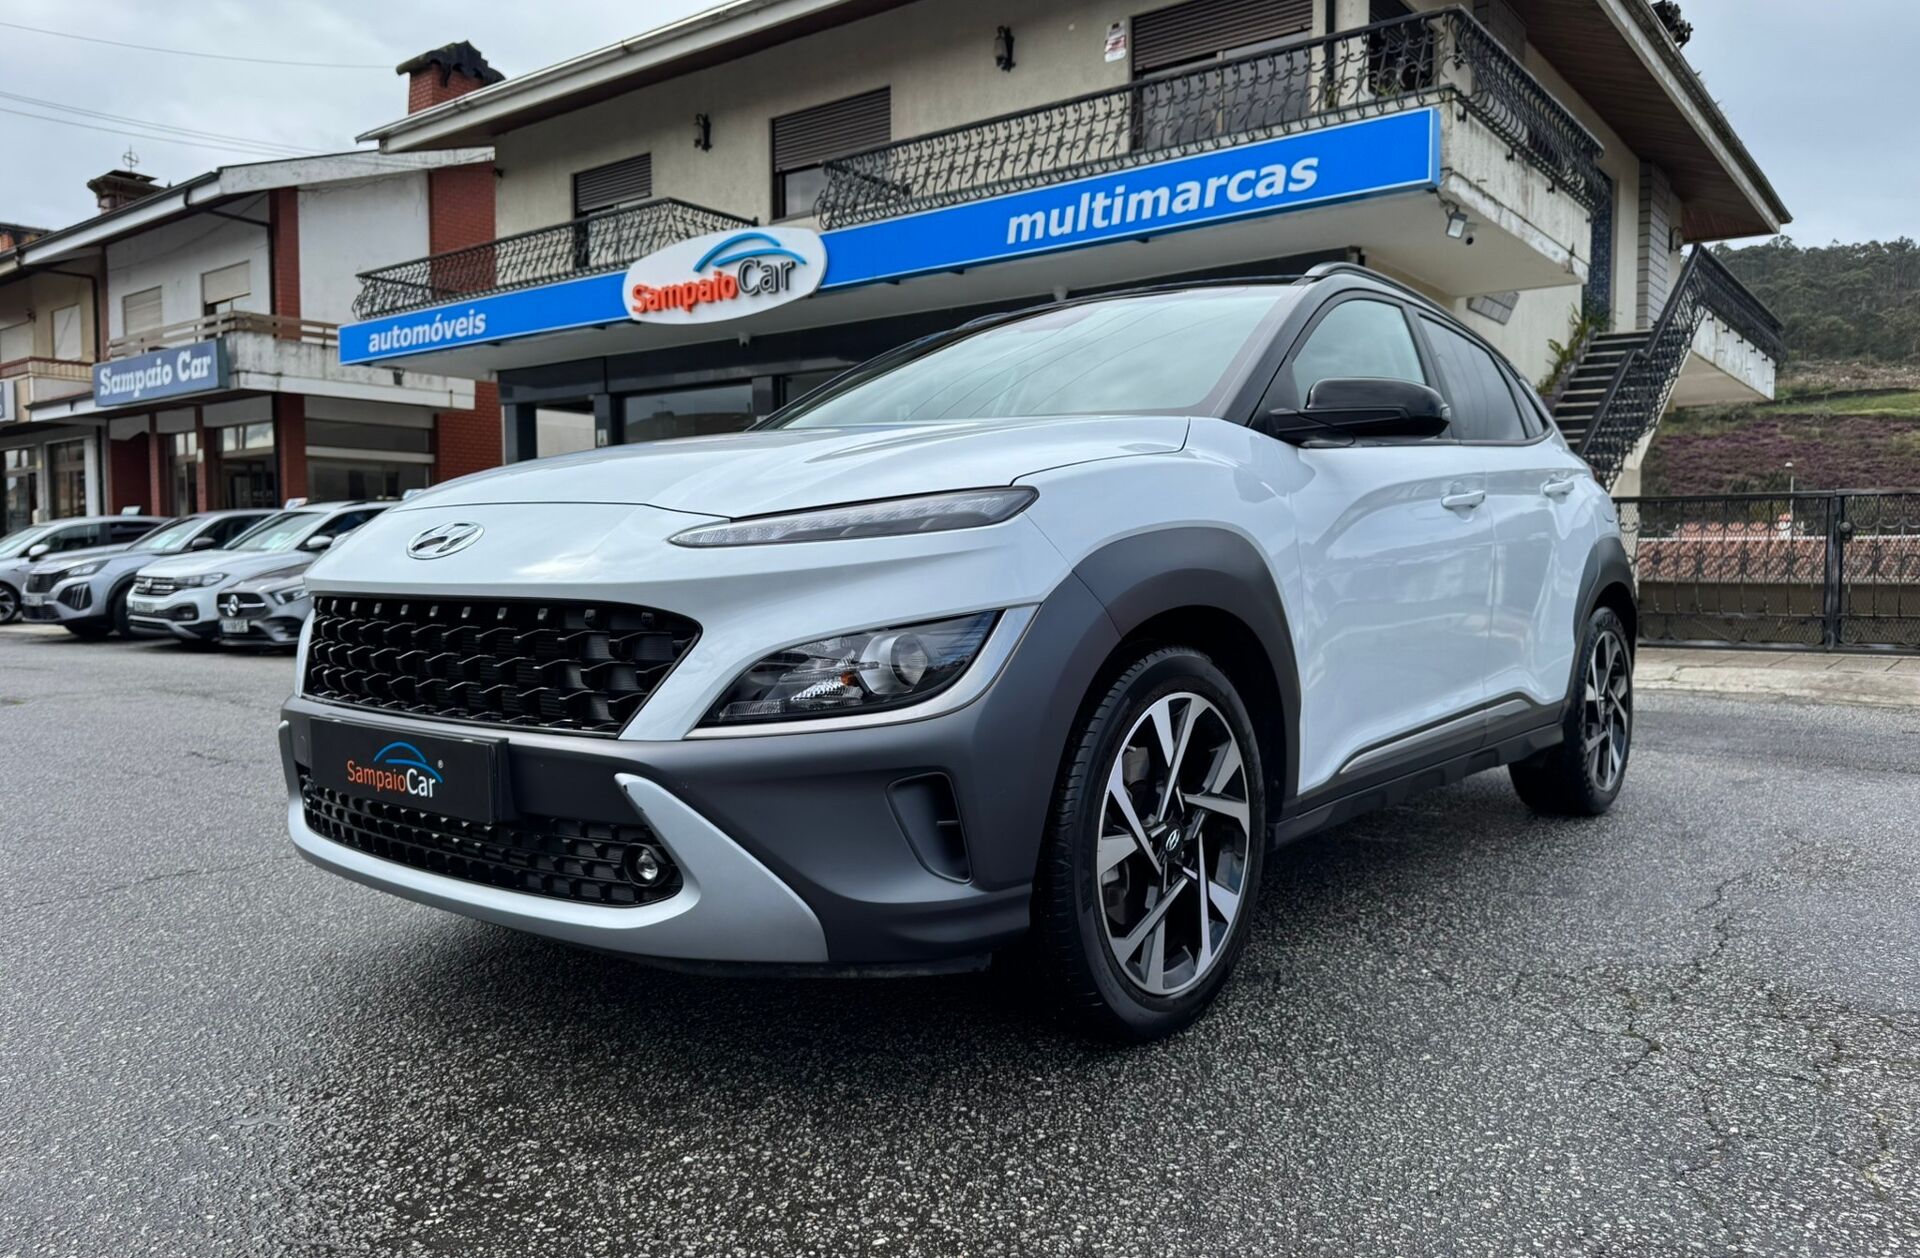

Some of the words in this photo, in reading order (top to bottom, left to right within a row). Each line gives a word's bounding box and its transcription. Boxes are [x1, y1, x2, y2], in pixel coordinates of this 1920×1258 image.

[1006, 156, 1319, 245] multimarcas
[368, 308, 486, 353] automóveis
[99, 358, 173, 398] Sampaio
[177, 350, 211, 382] Car
